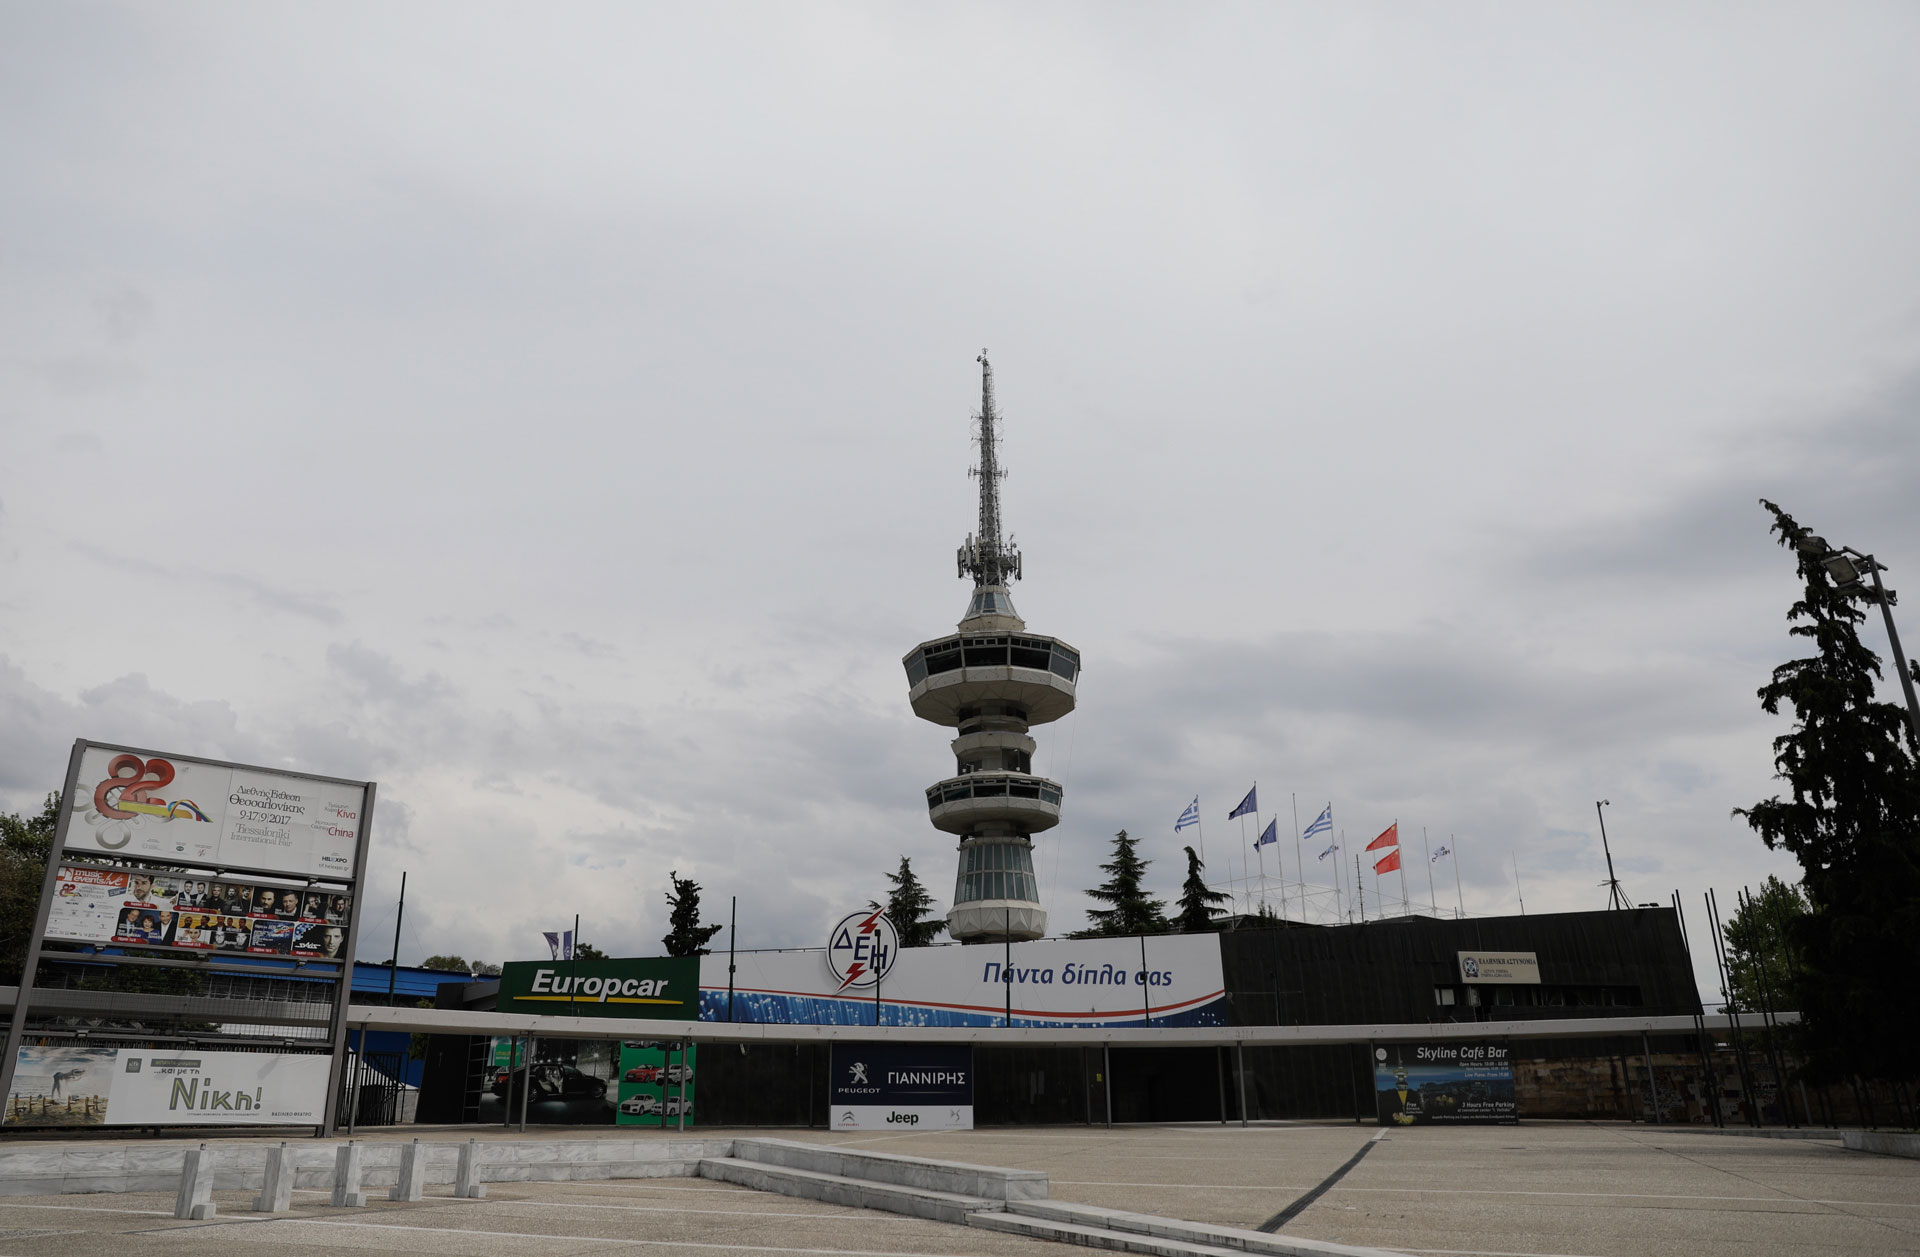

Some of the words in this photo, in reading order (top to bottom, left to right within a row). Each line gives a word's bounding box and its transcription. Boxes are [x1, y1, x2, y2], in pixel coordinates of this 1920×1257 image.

[230, 794, 305, 815] Θεσσαλονίκης
[336, 808, 356, 820] Κίνα
[236, 824, 291, 839] Thessaloniki
[328, 826, 354, 838] China
[74, 870, 104, 878] music
[74, 876, 104, 885] events
[833, 926, 888, 970] ΔΕΗ
[982, 962, 1054, 985] Πάντα
[1062, 962, 1127, 986] δίπλα
[532, 969, 668, 1002] Europcar
[1416, 1046, 1458, 1061] Skyline
[1460, 1046, 1484, 1060] Café
[1488, 1046, 1508, 1058] Bar
[888, 1072, 966, 1084] ΓΙΑΝΝΙΡΗΣ
[886, 1111, 919, 1125] Jeep
